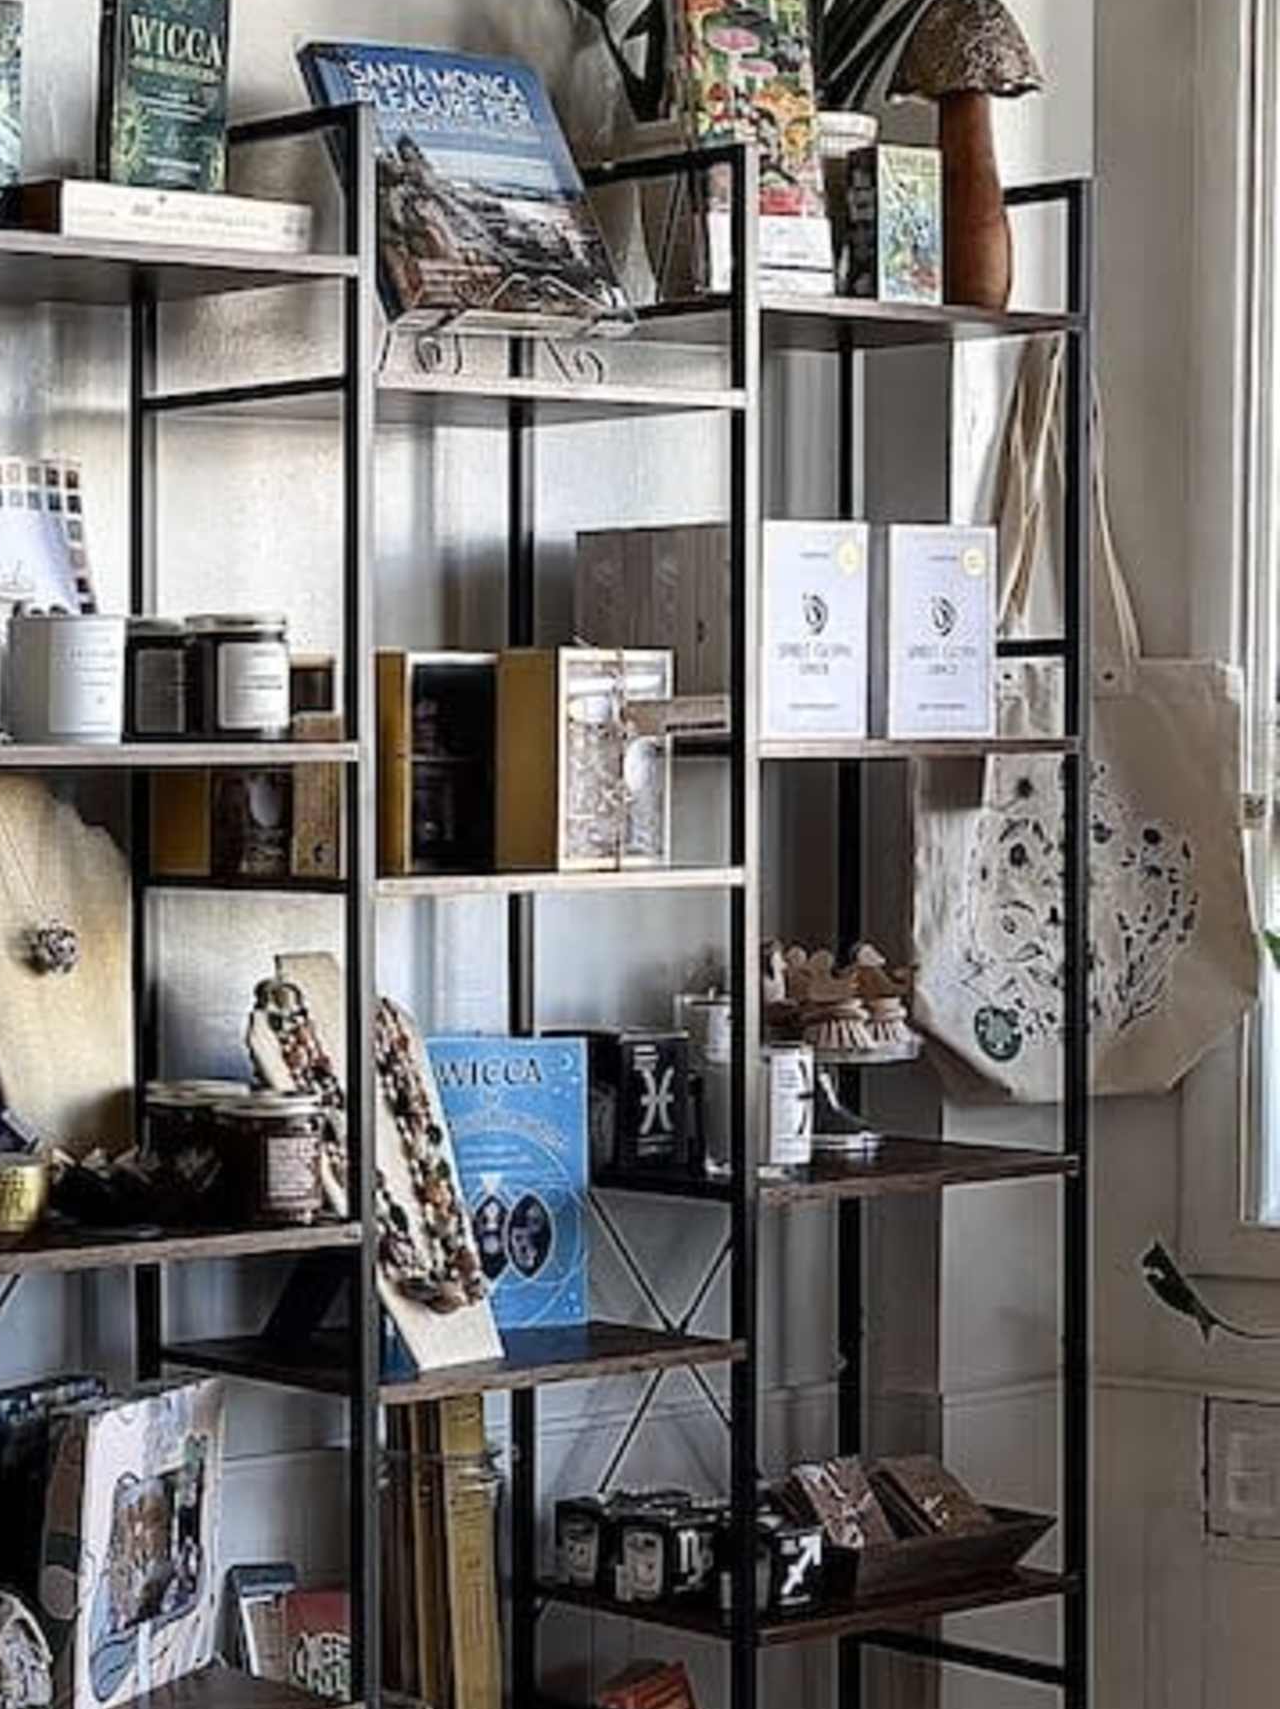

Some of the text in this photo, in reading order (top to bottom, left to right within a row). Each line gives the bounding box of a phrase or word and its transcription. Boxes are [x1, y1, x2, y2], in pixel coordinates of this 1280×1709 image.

[130, 12, 223, 68] WICCA
[347, 60, 527, 101] SANTA MONICA
[357, 85, 486, 120] PLEASURE
[433, 1057, 542, 1087] WICCA
